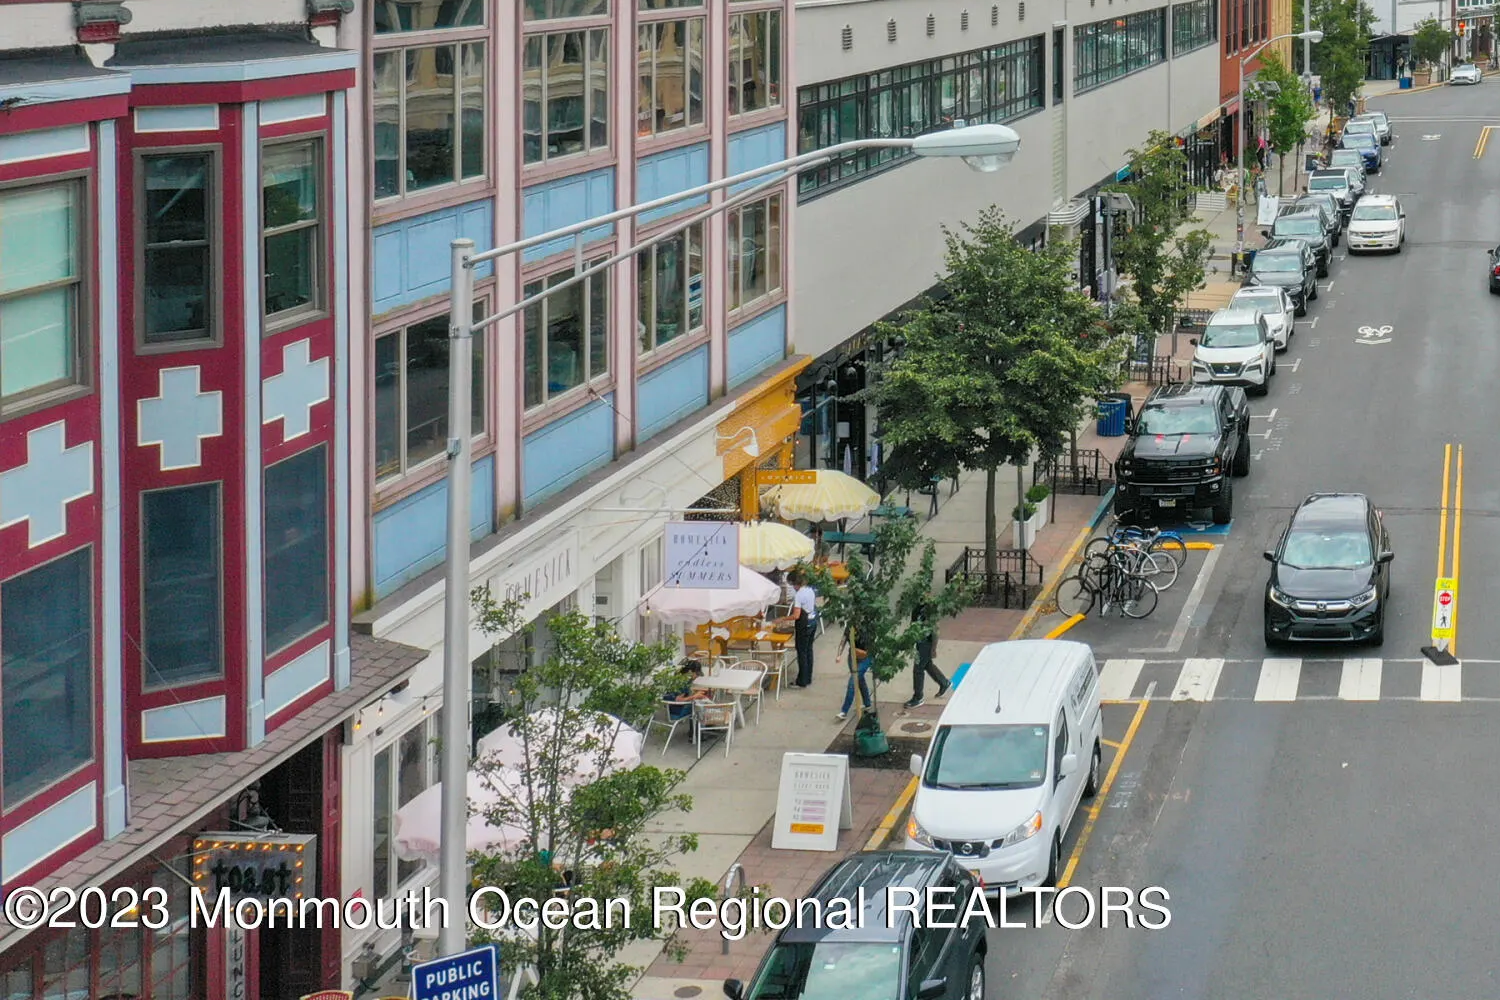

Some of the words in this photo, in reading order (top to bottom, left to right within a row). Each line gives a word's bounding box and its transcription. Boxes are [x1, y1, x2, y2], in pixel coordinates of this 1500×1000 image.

[211, 859, 292, 895] toast
[234, 929, 244, 1000] LUNC
[425, 960, 483, 989] PUBLIC
[421, 980, 490, 1000] RKING
